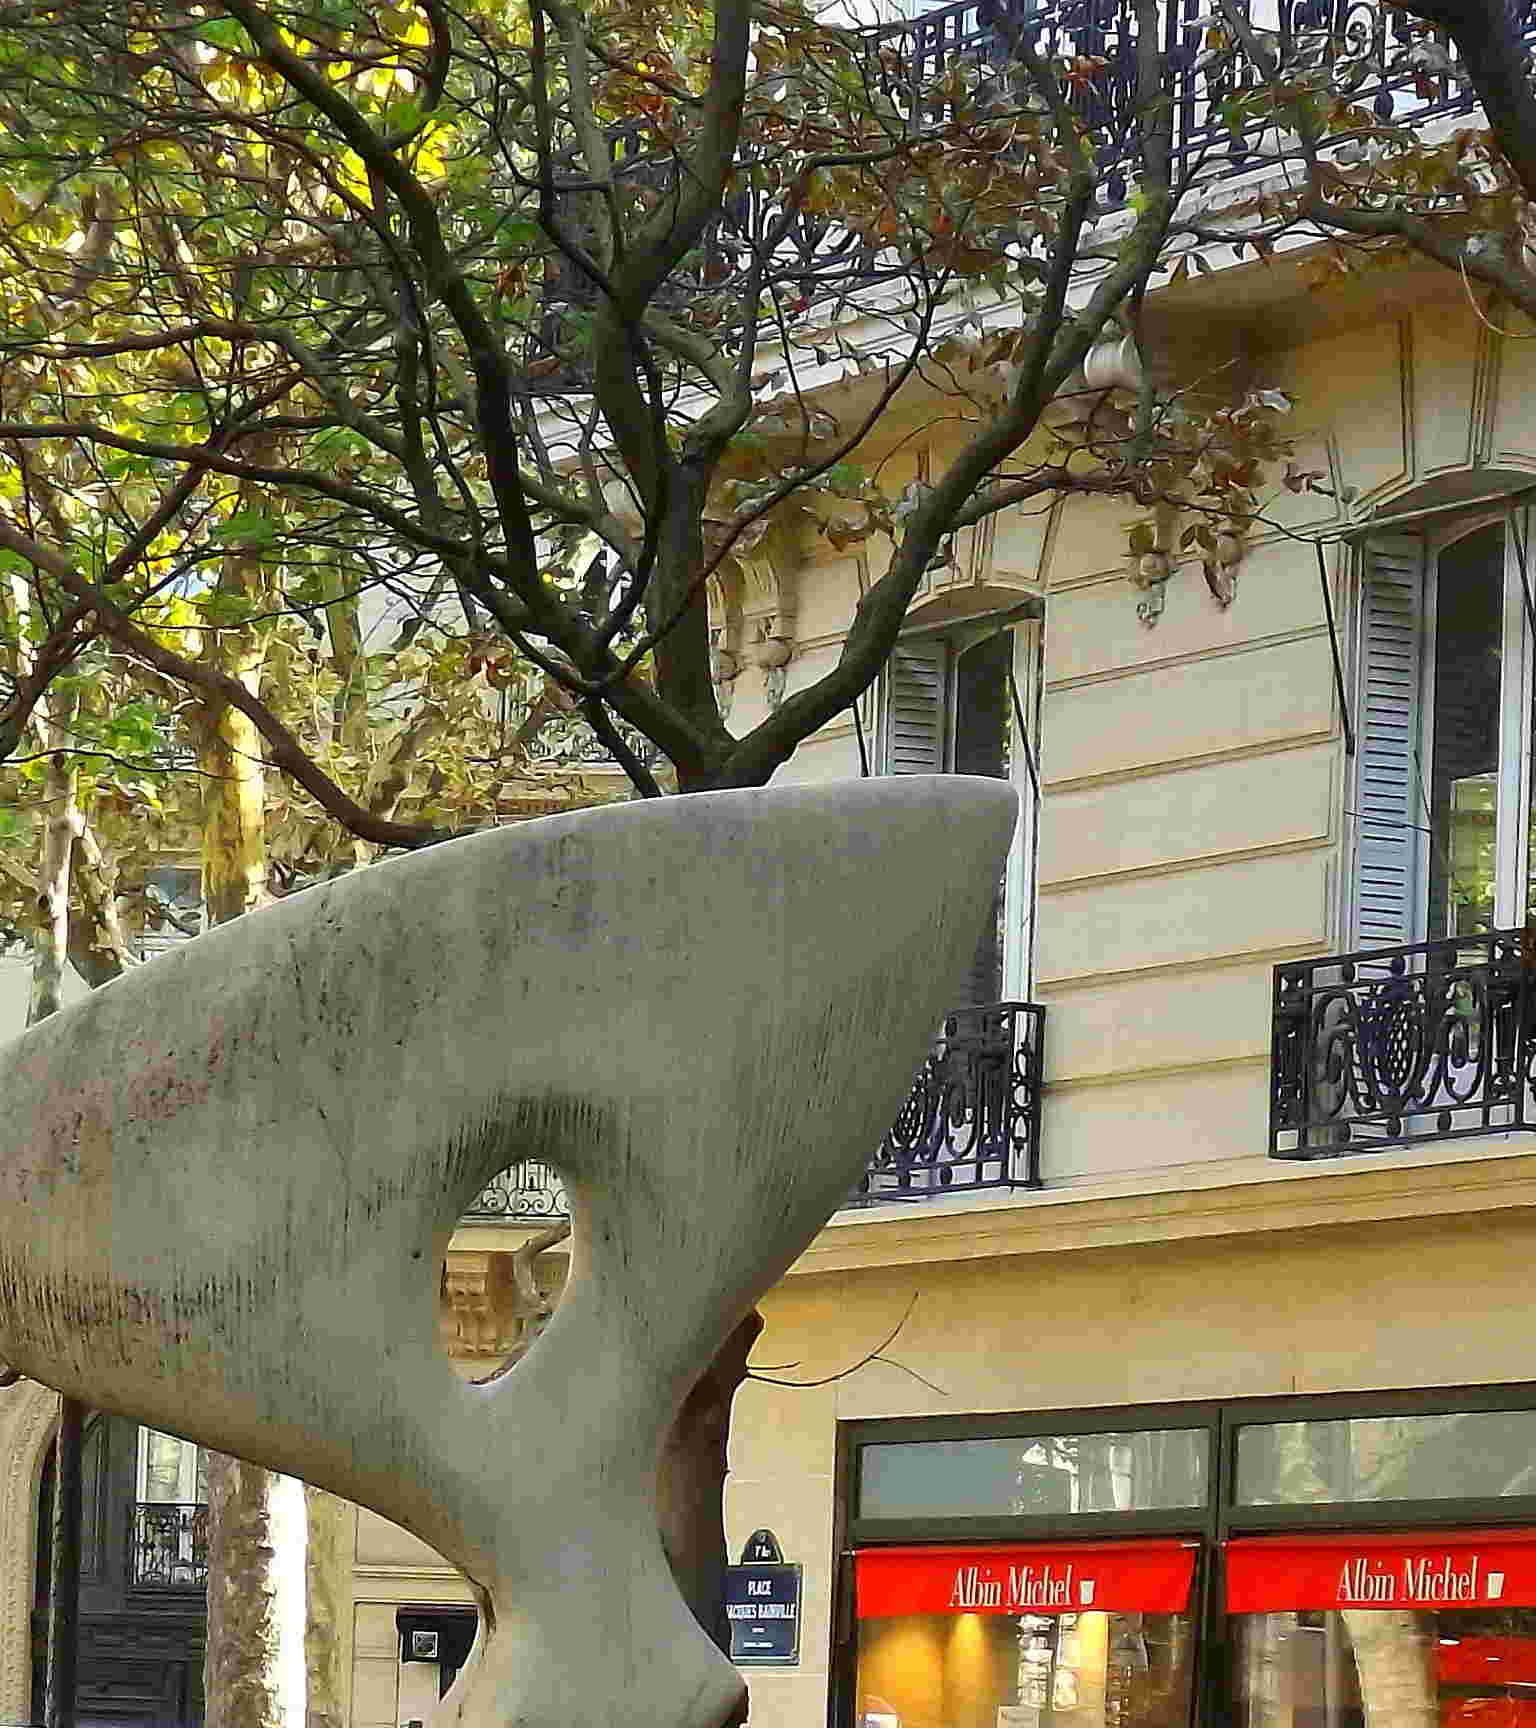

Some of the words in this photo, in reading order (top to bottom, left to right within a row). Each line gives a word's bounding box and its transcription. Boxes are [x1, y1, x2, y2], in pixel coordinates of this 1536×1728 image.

[747, 1580, 772, 1596] PLACE
[948, 1566, 1001, 1607] Albin
[1007, 1564, 1073, 1607] Michel
[1336, 1558, 1394, 1601] Albin
[1400, 1555, 1479, 1601] Michel
